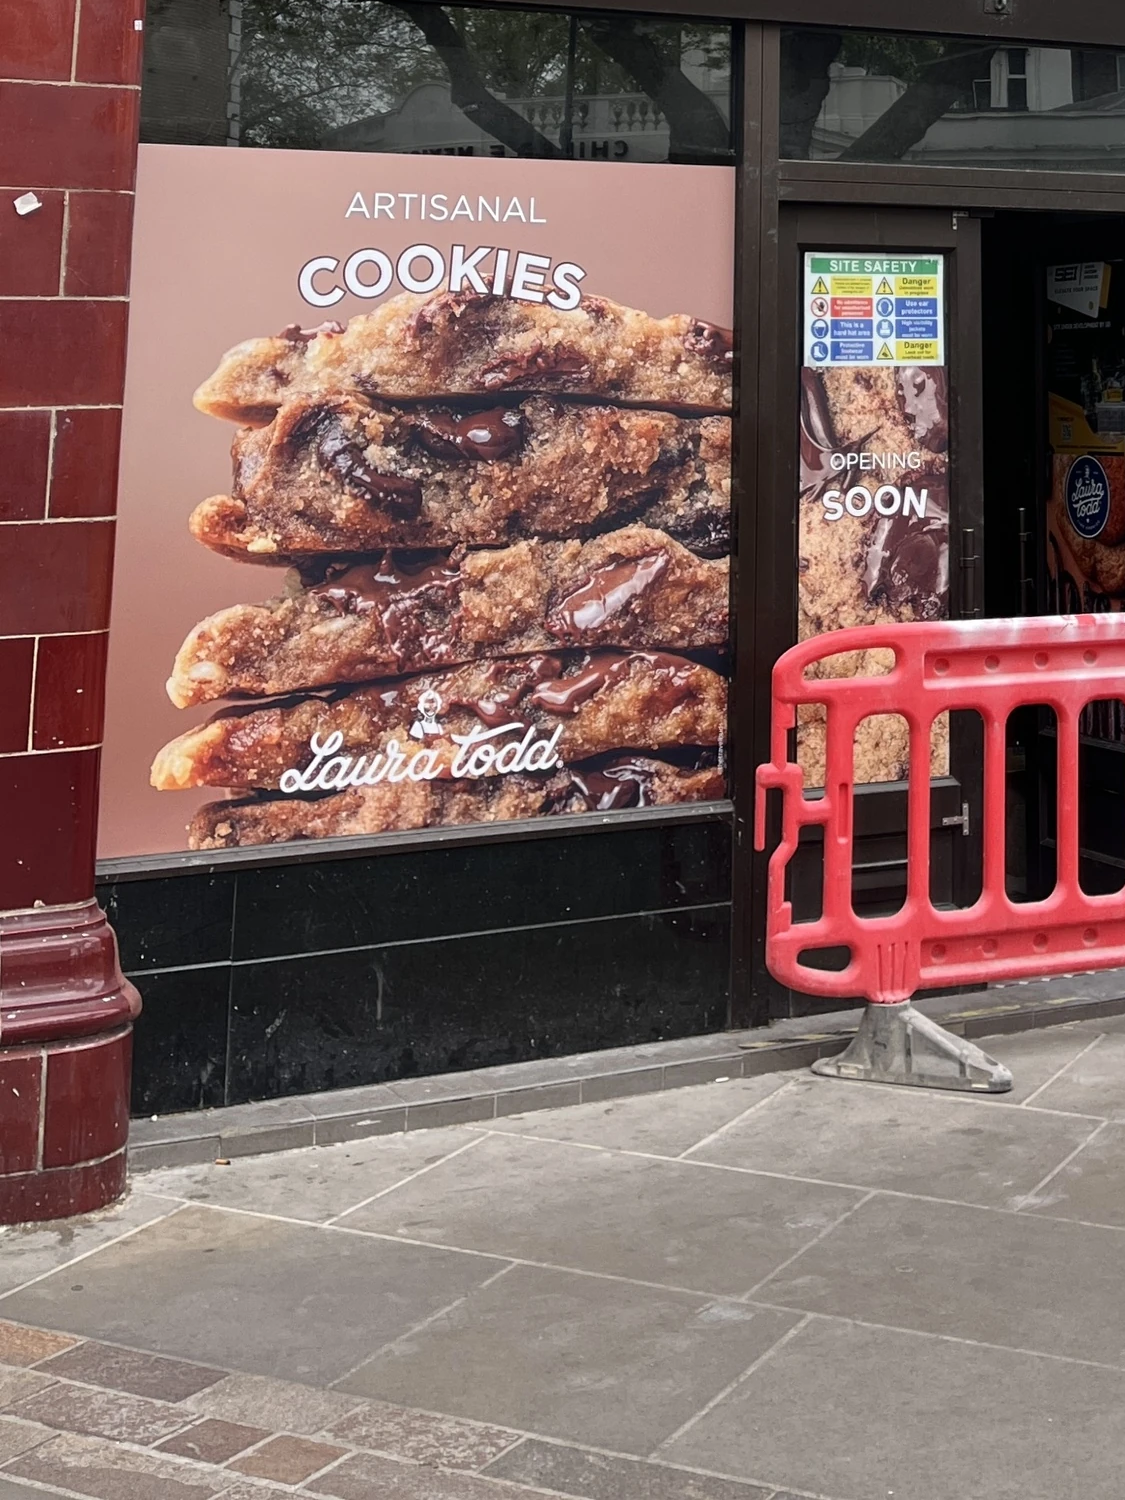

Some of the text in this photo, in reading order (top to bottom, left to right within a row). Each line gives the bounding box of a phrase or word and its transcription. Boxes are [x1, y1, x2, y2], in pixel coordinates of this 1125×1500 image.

[344, 191, 547, 224] ARTISANAL
[829, 260, 917, 272] SITE SAFETY
[298, 243, 586, 311] COOKIES
[902, 277, 931, 286] Danger
[901, 308, 933, 316] protectors
[904, 341, 932, 350] Danger
[830, 451, 921, 470] OPENING
[1071, 478, 1104, 502] Laura
[822, 484, 928, 521] SOON
[279, 729, 446, 794] Laura
